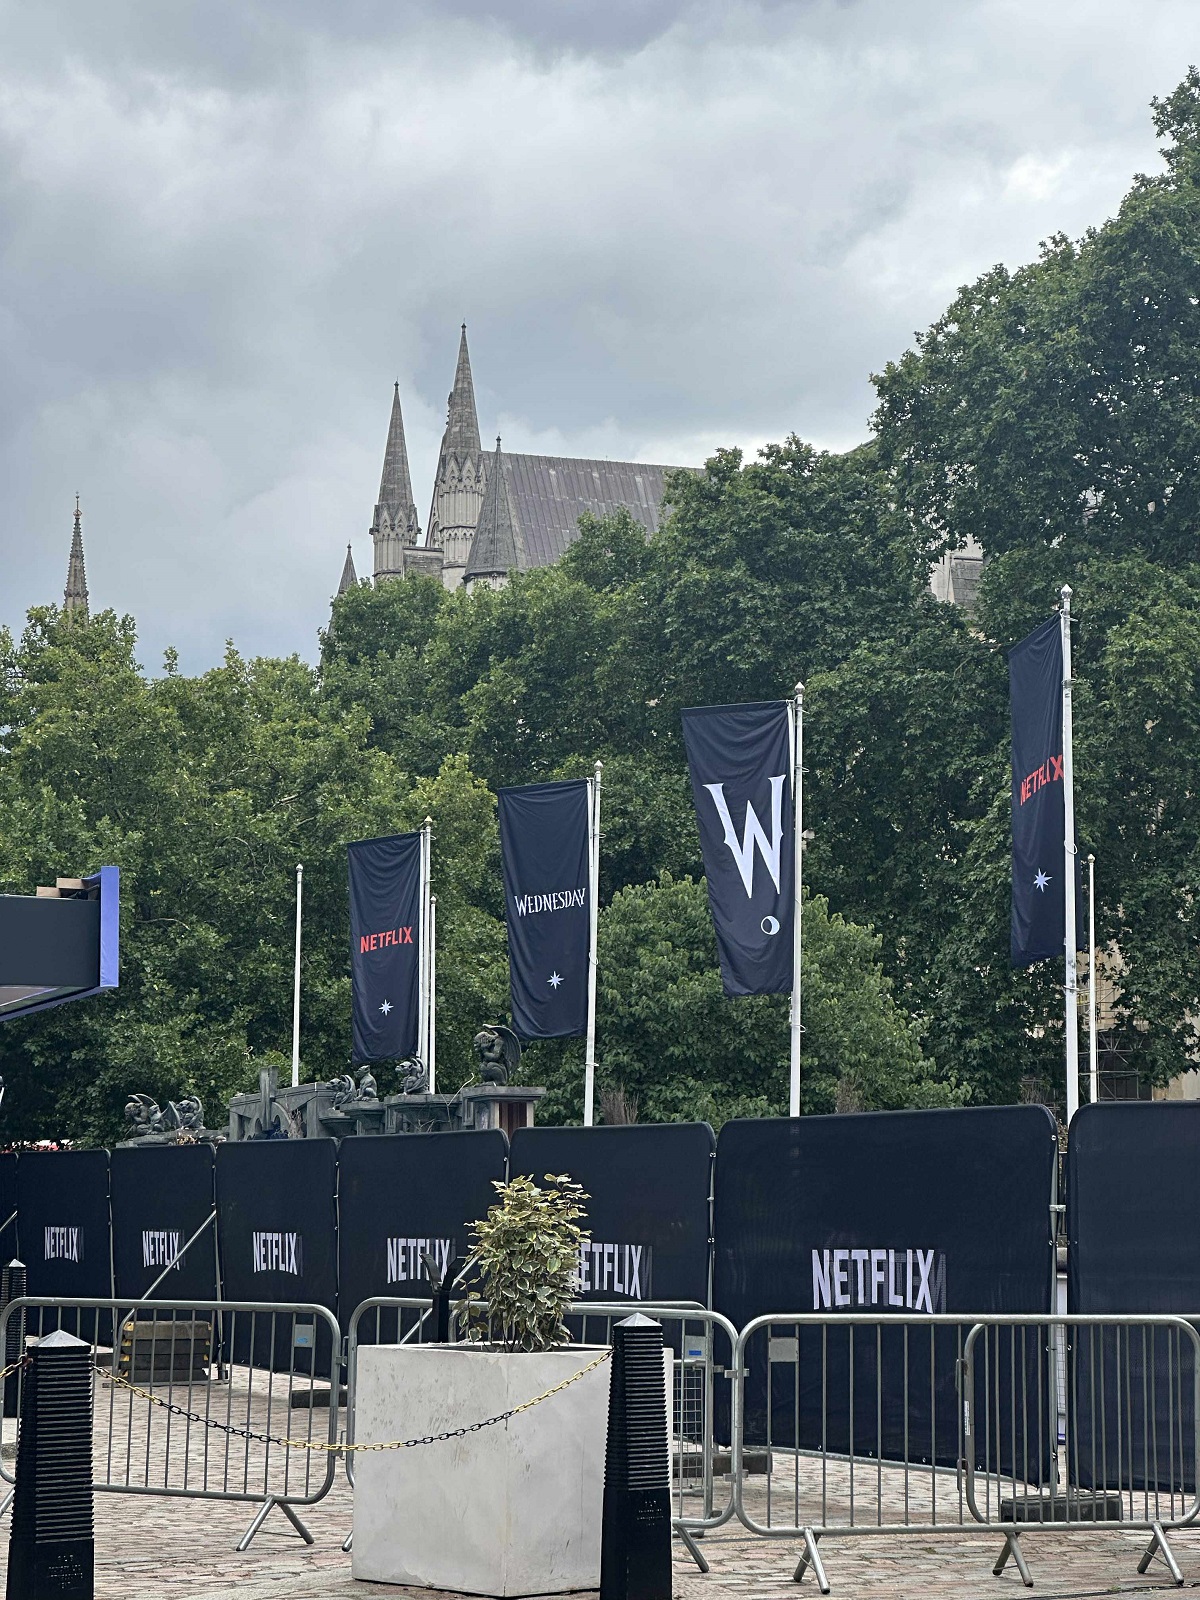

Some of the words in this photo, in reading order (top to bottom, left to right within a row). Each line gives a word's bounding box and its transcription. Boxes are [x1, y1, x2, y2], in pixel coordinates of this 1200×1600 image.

[1020, 754, 1064, 806] NETFLIX
[703, 775, 787, 899] W
[514, 888, 586, 917] WEDNESDAY
[360, 926, 413, 953] NETFLIX
[44, 1226, 79, 1263] NETFLIX
[142, 1230, 180, 1270] NETFLIX
[252, 1231, 298, 1276] NETFLIX
[812, 1249, 935, 1314] NETFLIX
